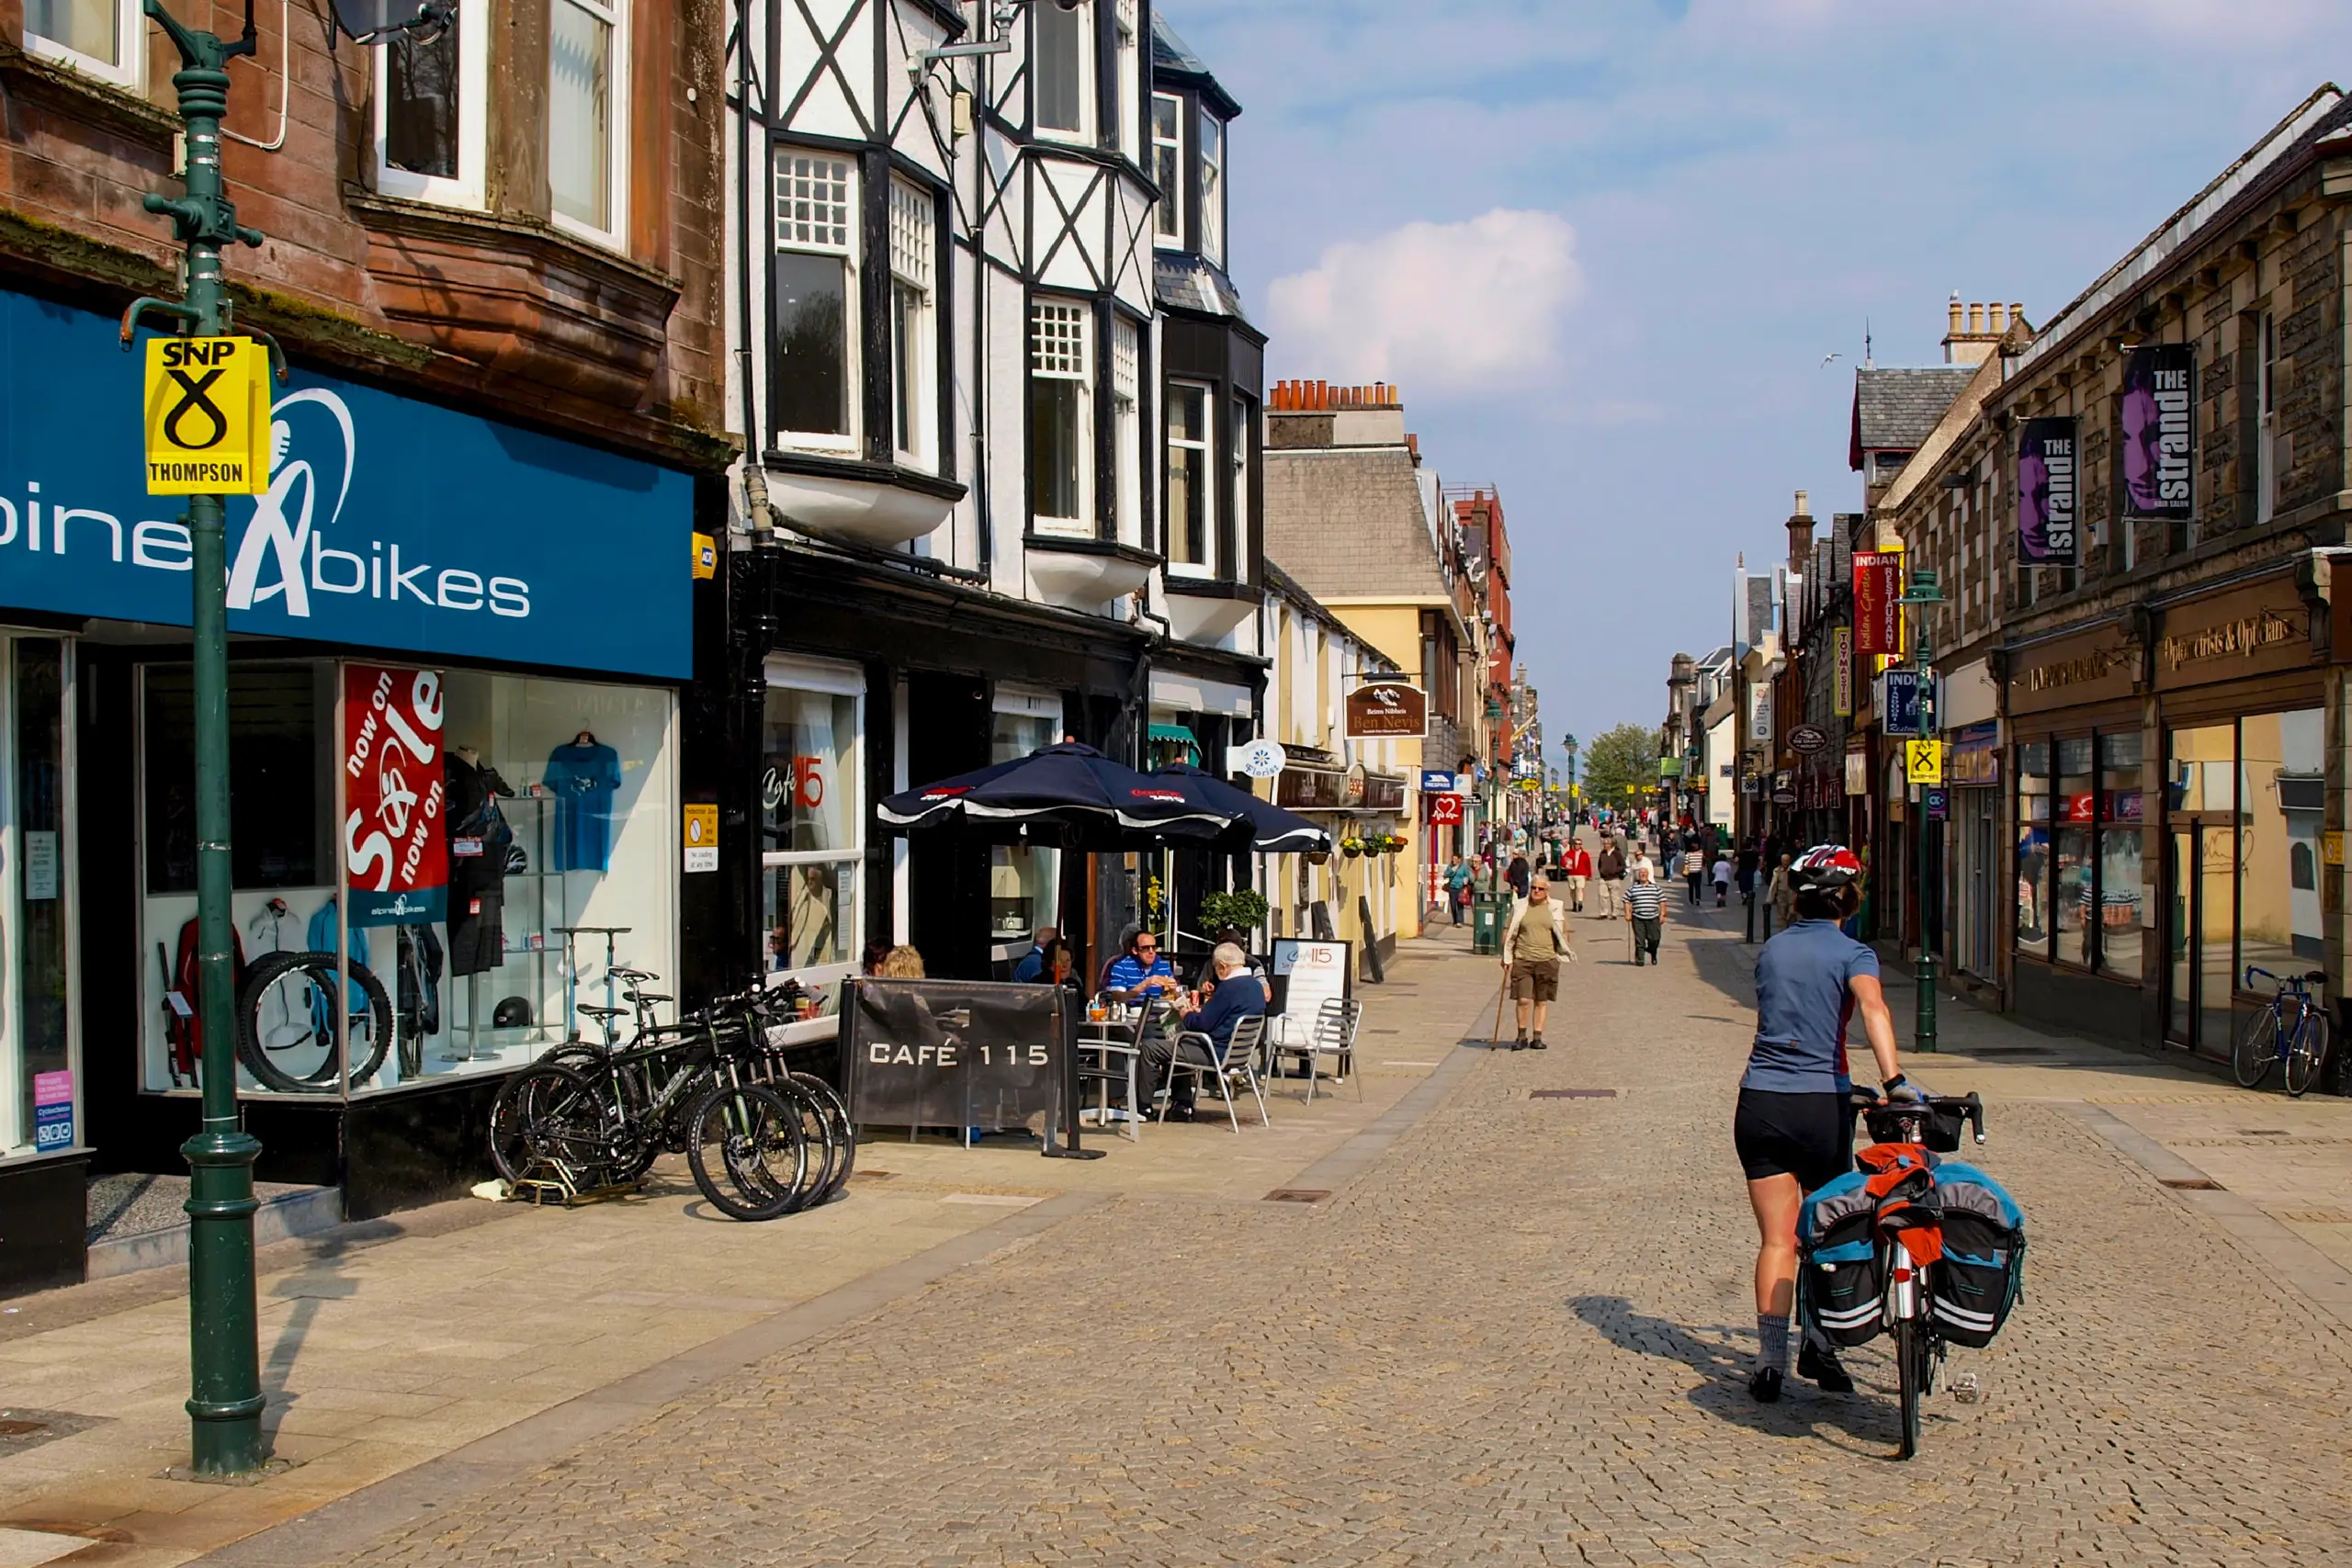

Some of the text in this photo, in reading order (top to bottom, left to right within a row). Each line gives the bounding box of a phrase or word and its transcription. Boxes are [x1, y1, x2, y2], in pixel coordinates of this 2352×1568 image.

[163, 342, 236, 367] SNP
[2154, 370, 2188, 389] THE
[2043, 439, 2072, 455] THE
[2154, 390, 2189, 500] strand
[150, 463, 243, 482] THOMPSON
[2044, 457, 2073, 549] strand
[311, 530, 530, 618] bikes
[1856, 556, 1898, 567] INDIAN
[1884, 567, 1894, 649] RESTAURANT
[1860, 614, 1874, 649] Indian
[2226, 623, 2235, 653] &
[1839, 633, 1848, 709] TOYMASTER
[1889, 673, 1935, 685] INDIN
[346, 671, 393, 778] now on
[1354, 715, 1420, 729] Ben Nevis
[1245, 763, 1279, 776] Florist
[401, 780, 443, 885] now on
[1311, 947, 1332, 964] 115
[869, 1038, 957, 1066] CAFÉ
